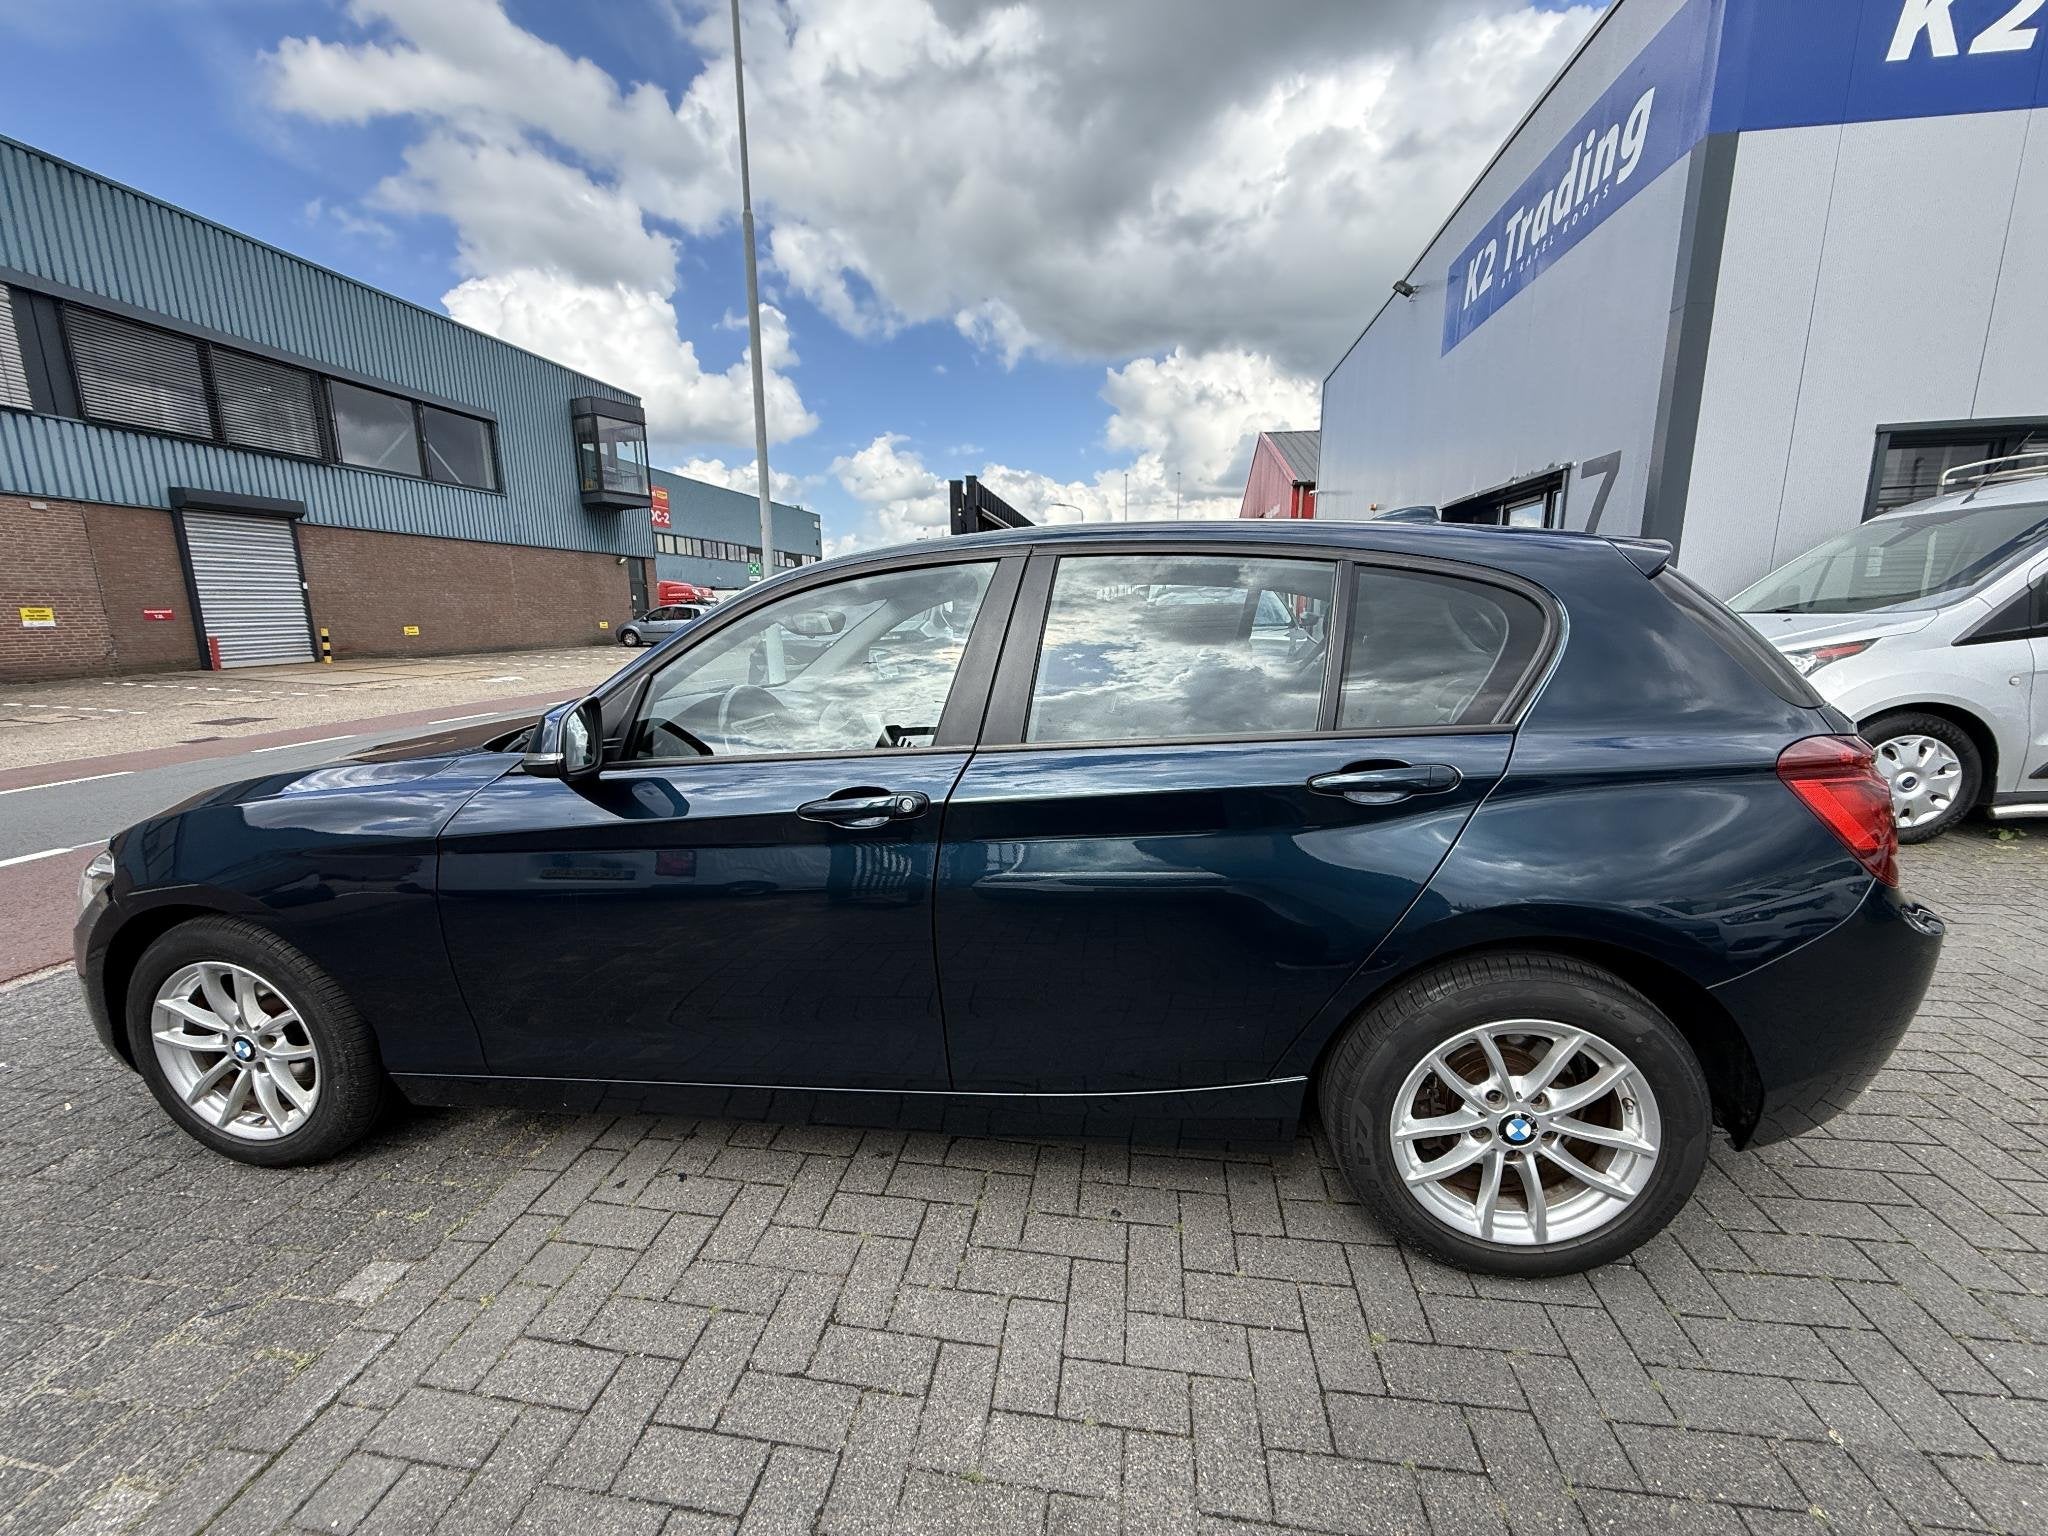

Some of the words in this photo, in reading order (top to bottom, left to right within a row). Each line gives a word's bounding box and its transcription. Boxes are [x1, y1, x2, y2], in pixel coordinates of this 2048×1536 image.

[1463, 238, 1497, 311] K2
[1504, 86, 1656, 273] Trading
[1580, 450, 1622, 534] 7
